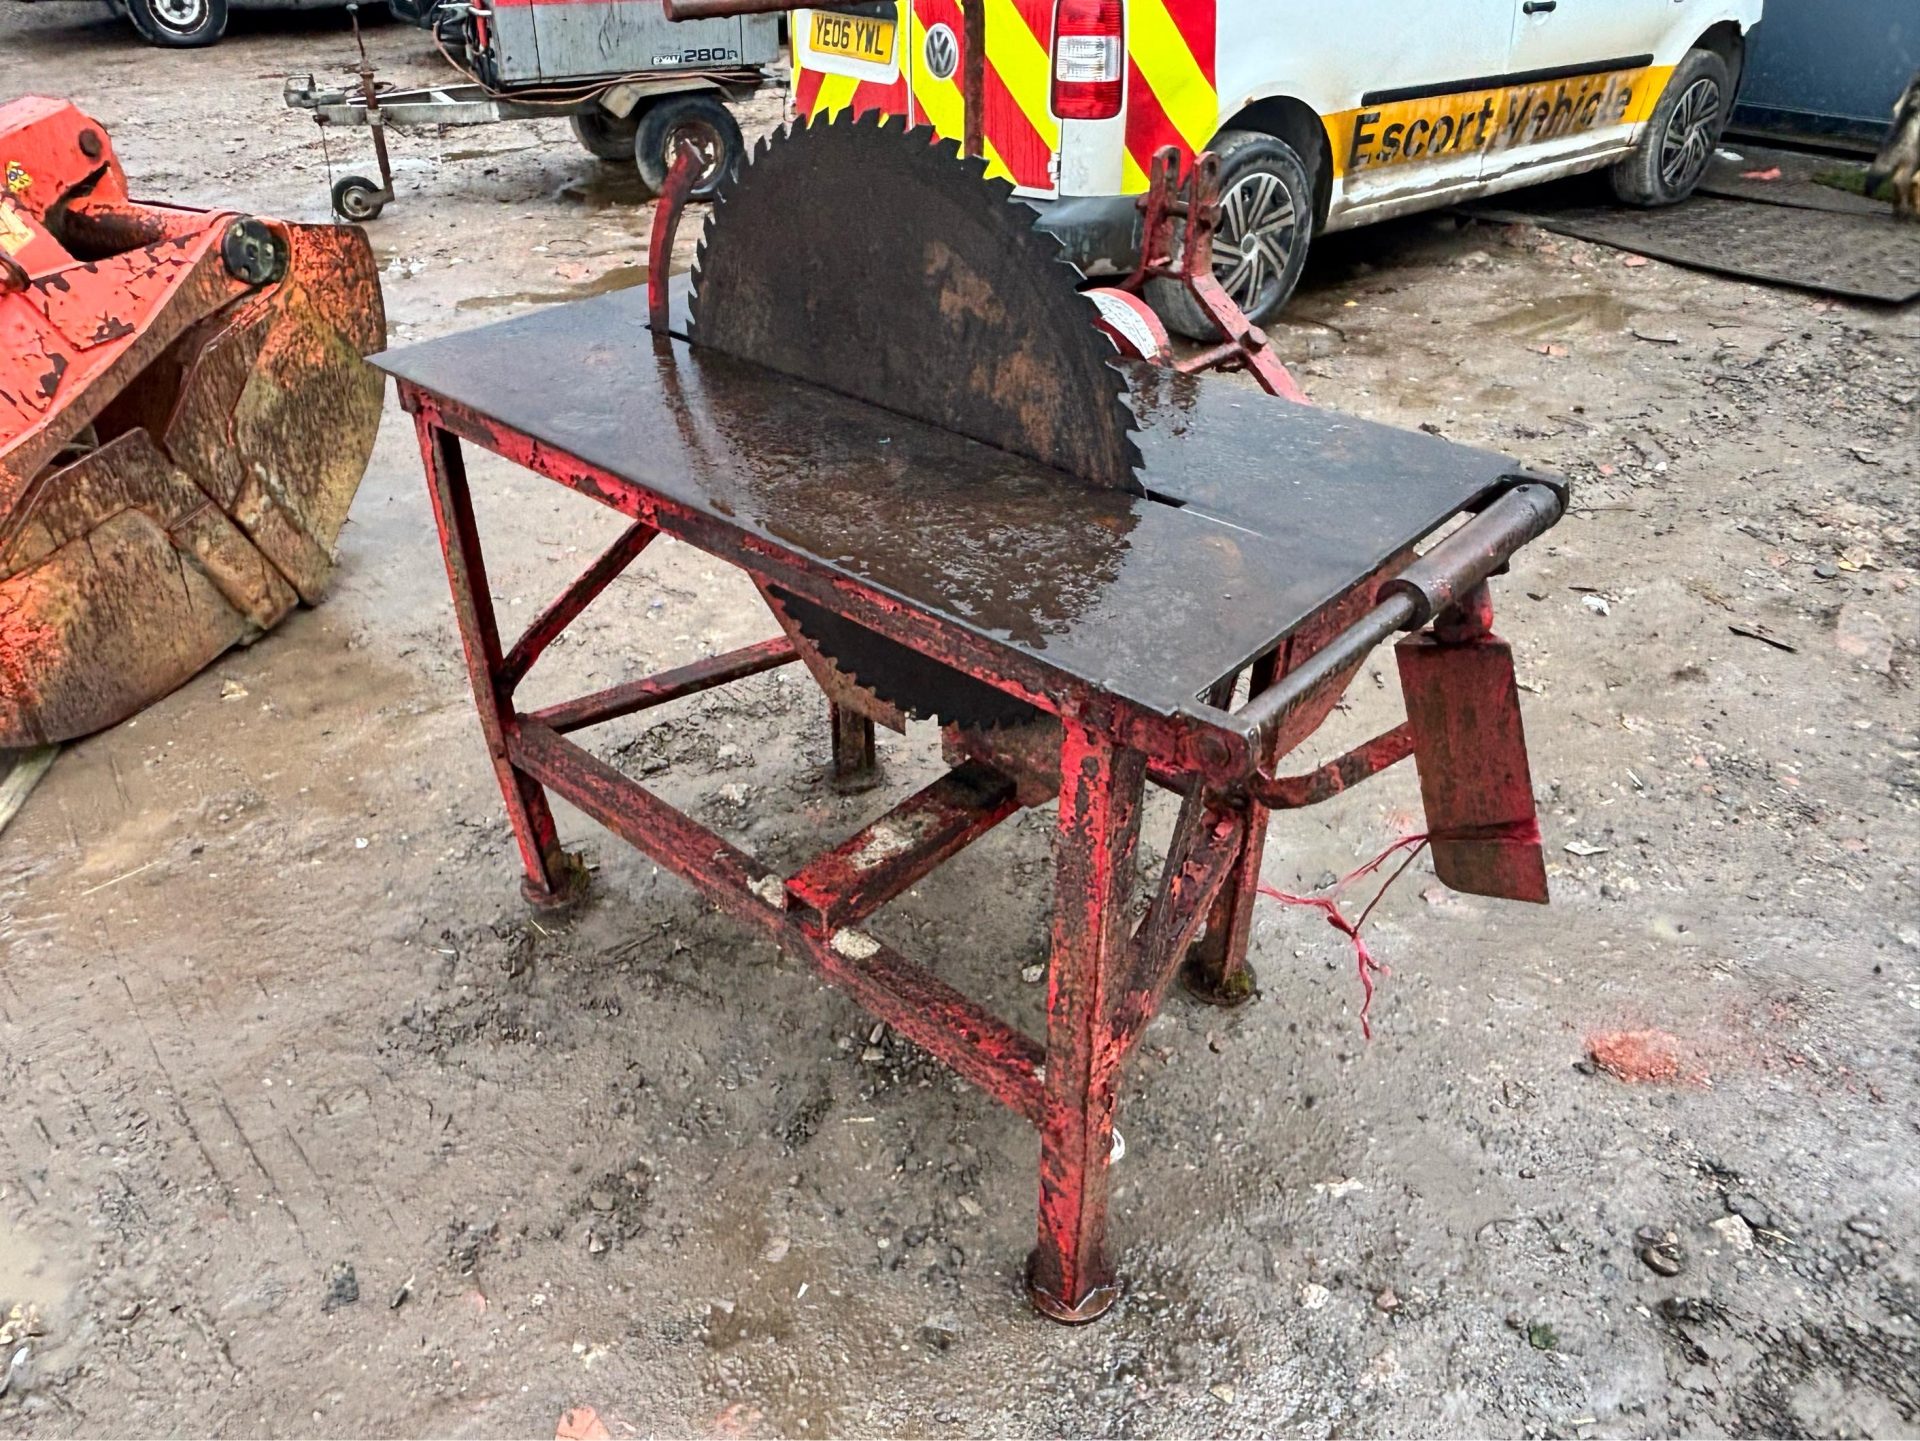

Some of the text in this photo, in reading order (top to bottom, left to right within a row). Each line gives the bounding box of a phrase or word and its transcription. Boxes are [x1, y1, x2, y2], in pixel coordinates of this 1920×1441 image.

[816, 13, 884, 56] YE06 YWL
[1351, 78, 1632, 167] Escort Vehicle
